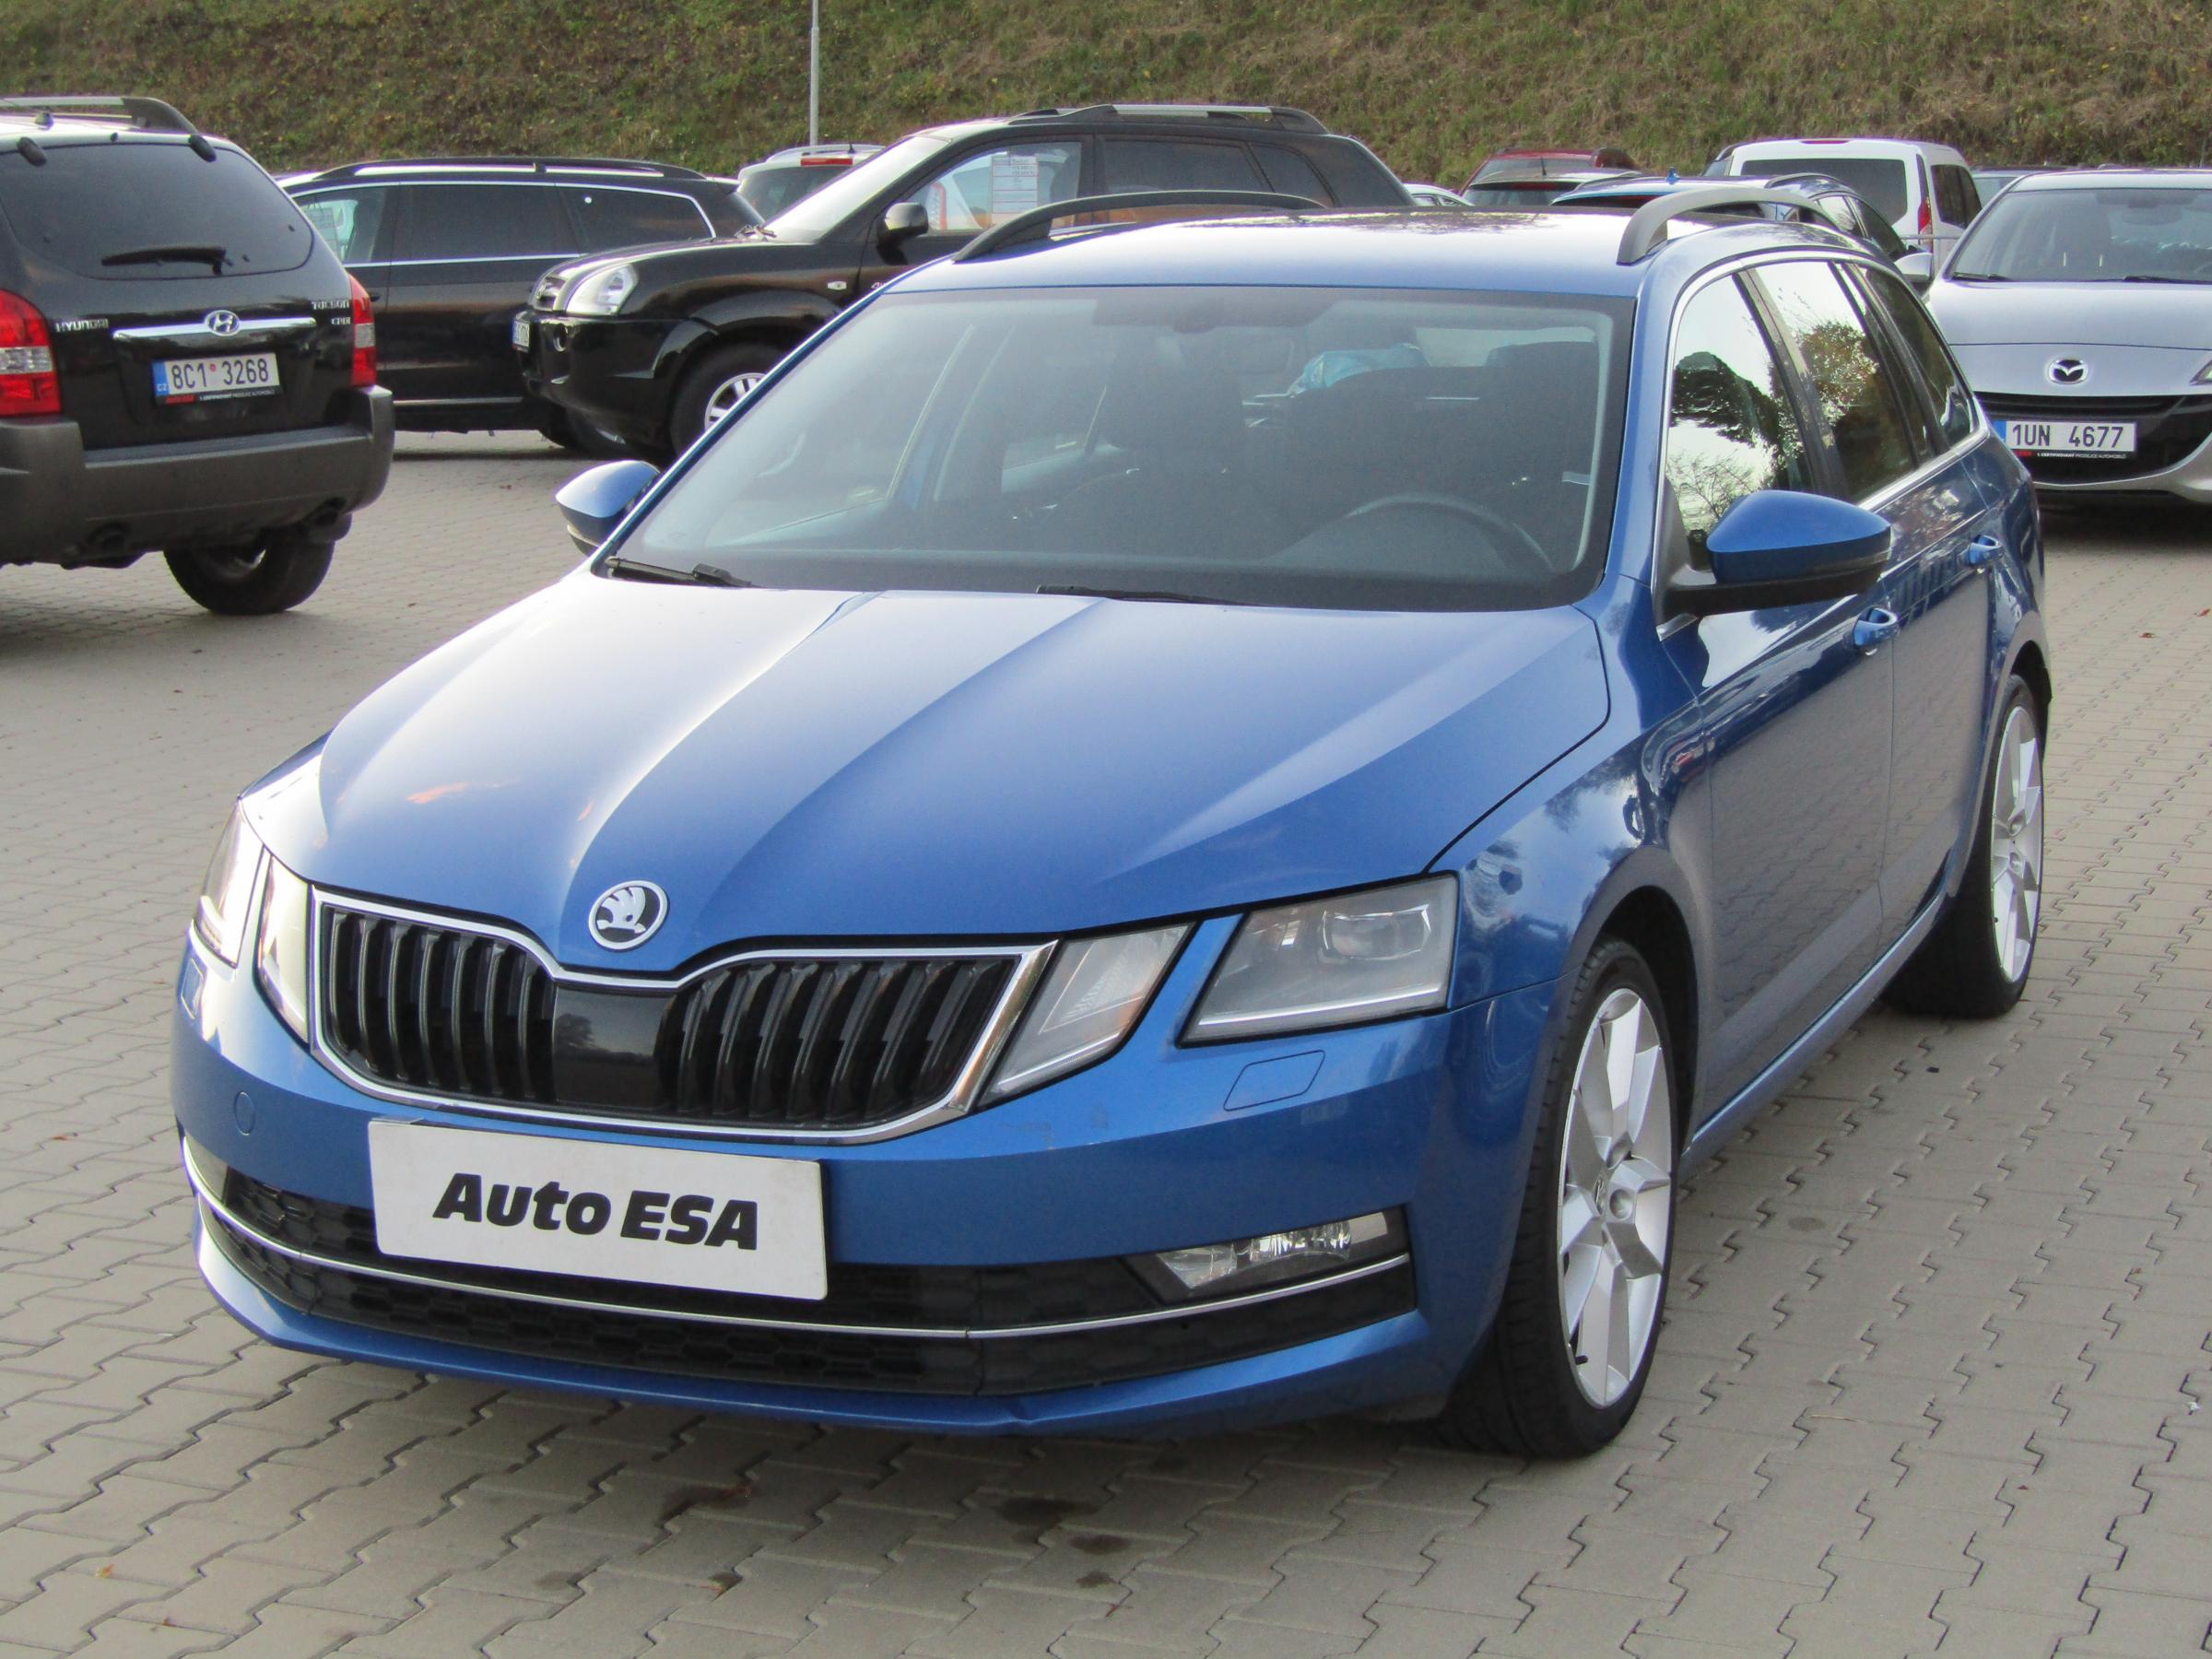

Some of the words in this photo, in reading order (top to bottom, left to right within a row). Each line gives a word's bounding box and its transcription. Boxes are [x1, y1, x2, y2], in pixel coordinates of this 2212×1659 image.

[55, 318, 109, 333] HYUNDAI
[171, 362, 206, 389] 8C1
[222, 358, 268, 385] 3268
[2012, 424, 2051, 447] 1UN
[2068, 426, 2124, 448] 4677
[432, 1172, 612, 1236] Auto
[620, 1190, 758, 1251] ESA
